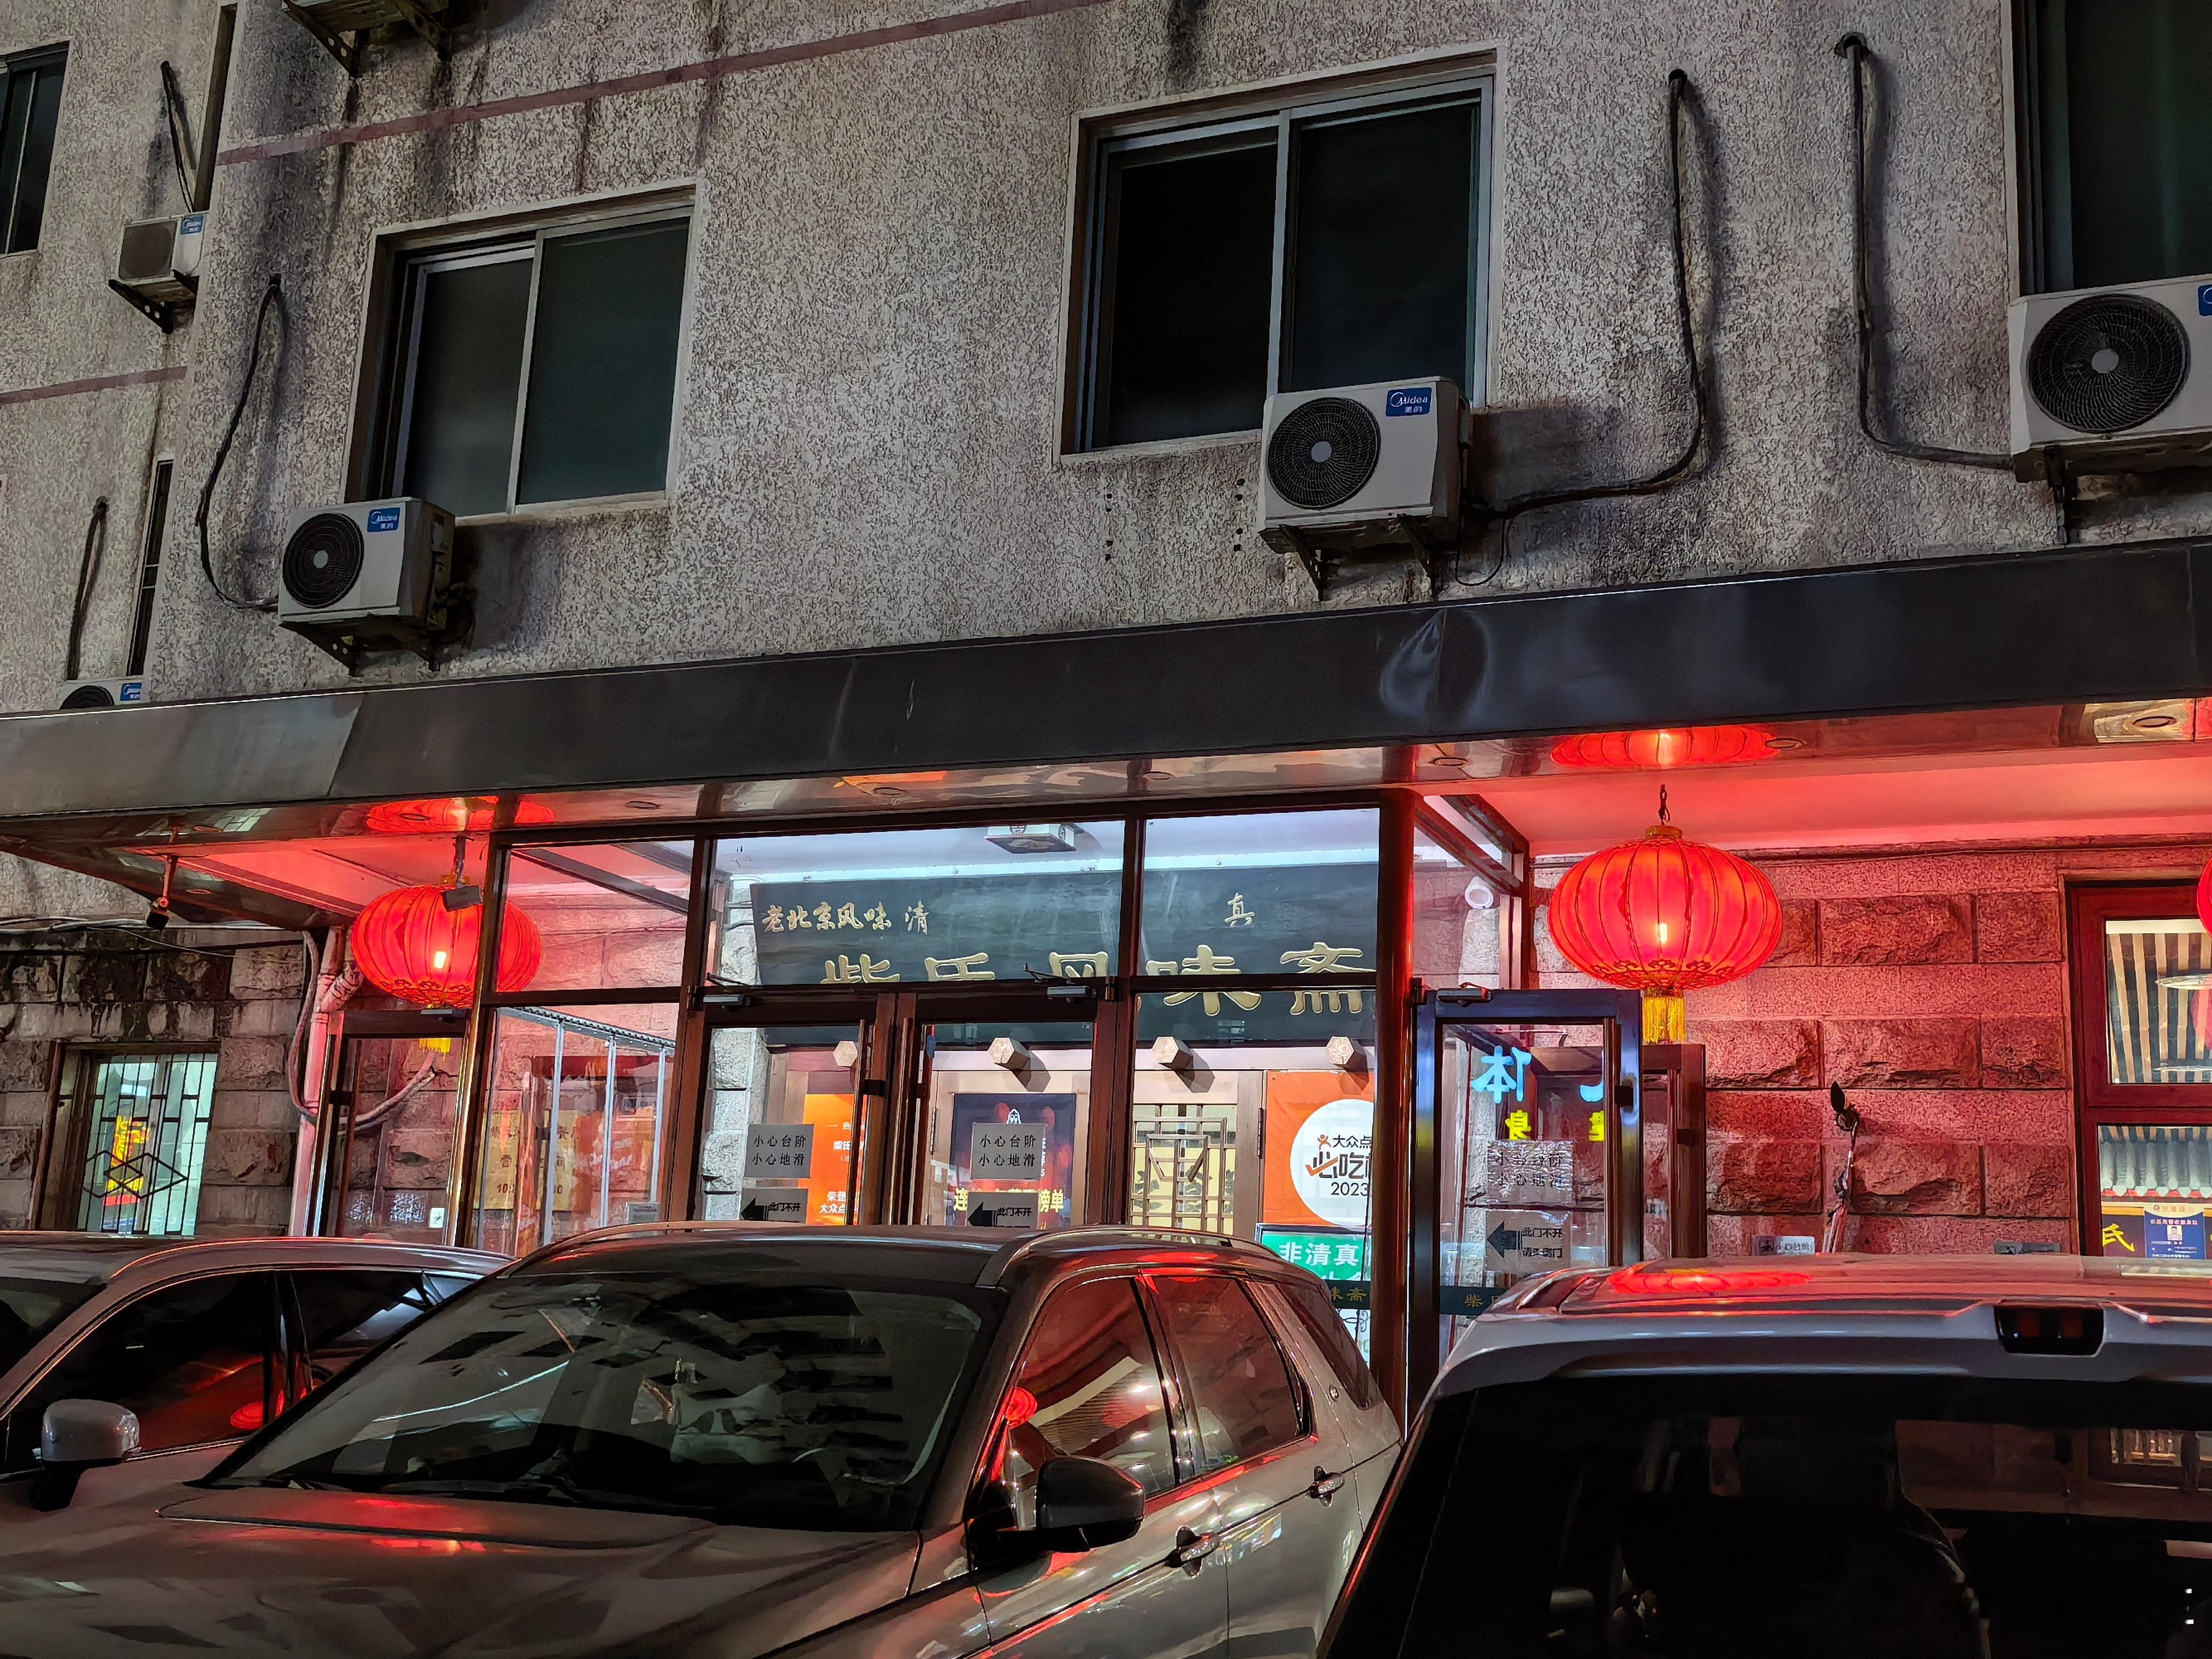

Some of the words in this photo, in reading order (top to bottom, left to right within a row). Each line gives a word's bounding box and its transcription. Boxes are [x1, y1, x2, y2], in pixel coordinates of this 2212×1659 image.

[762, 901, 892, 932] 老北京风味
[753, 1134, 807, 1148] 小心台阶
[979, 1134, 1037, 1149] 小心台阶
[751, 1153, 805, 1166] 小心地滑
[978, 1153, 1036, 1167] 小心地滑
[1331, 1182, 1369, 1197] 2023
[1279, 1242, 1359, 1266] 非清真
